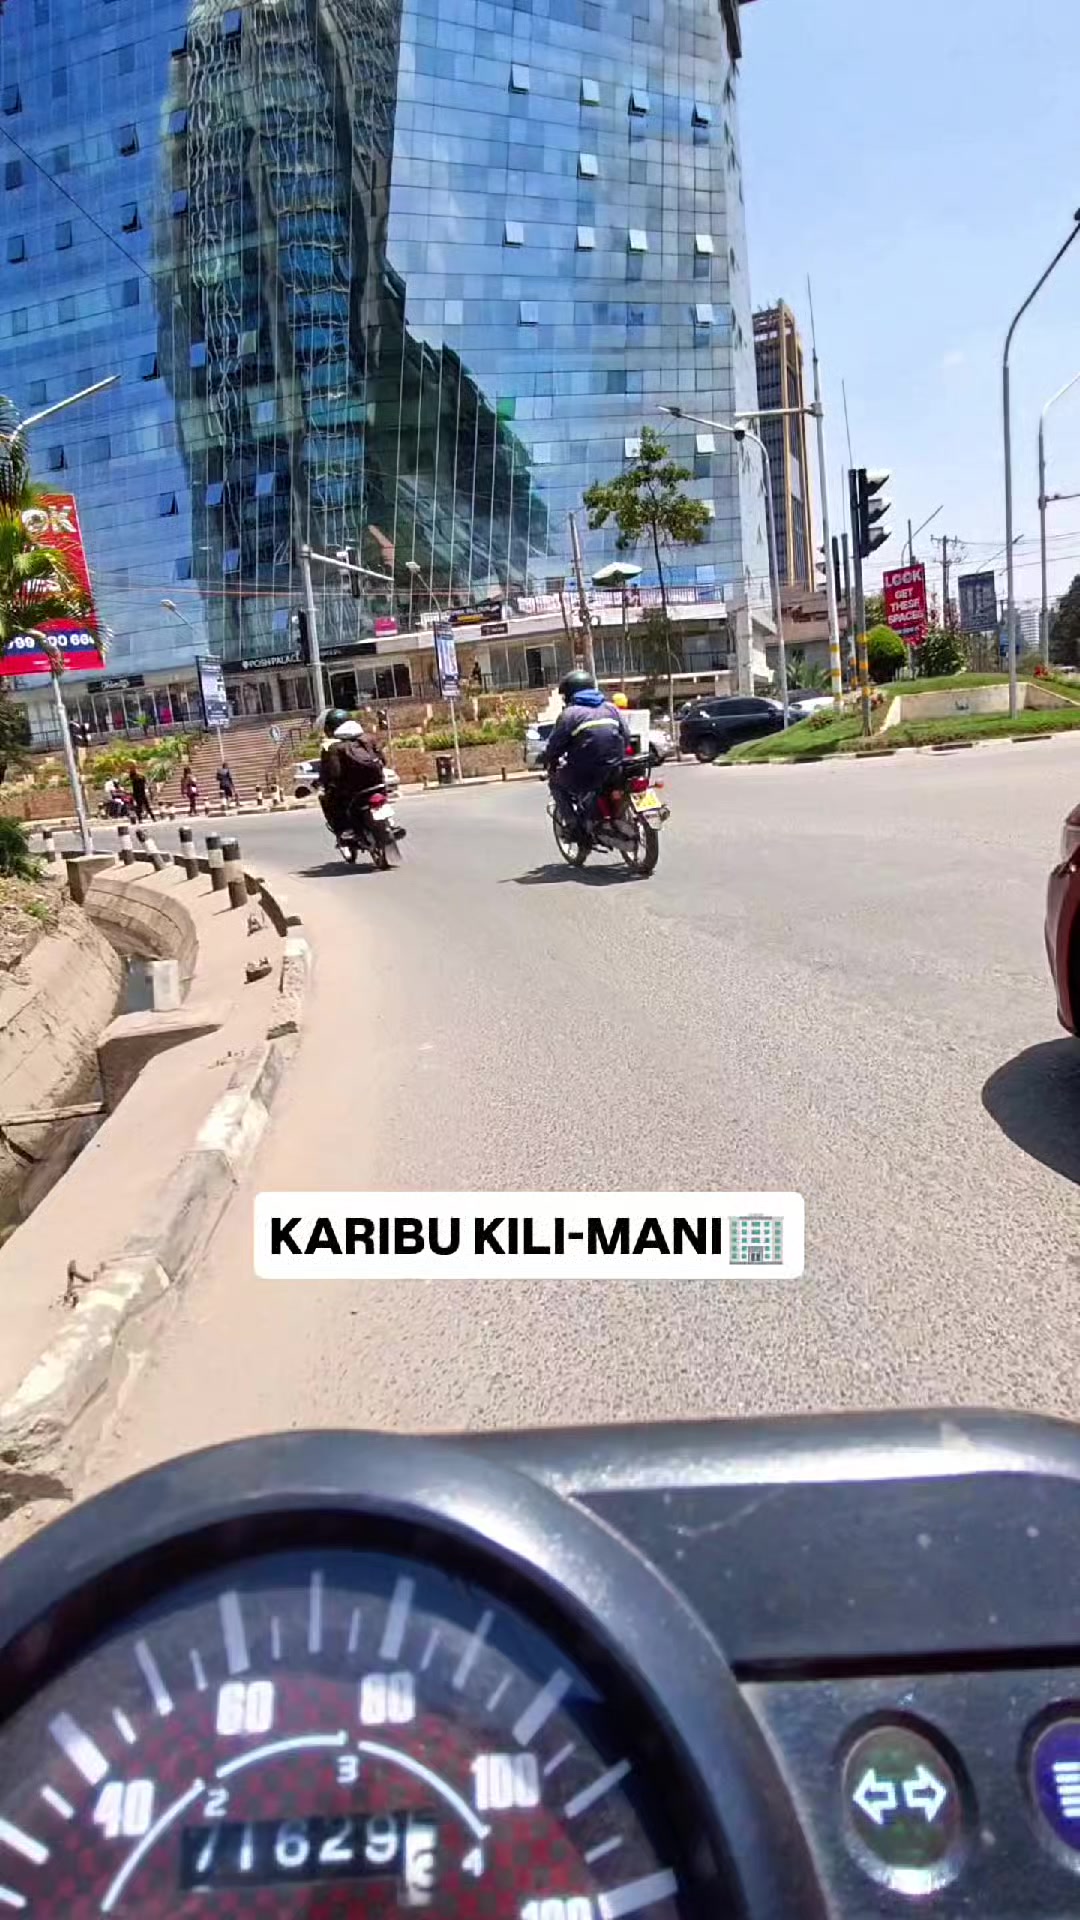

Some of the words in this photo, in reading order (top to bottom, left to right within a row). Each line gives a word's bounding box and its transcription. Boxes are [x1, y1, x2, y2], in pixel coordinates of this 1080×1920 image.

[885, 569, 922, 587] LOOK
[889, 598, 920, 612] THESE
[895, 588, 914, 599] GET
[217, 1681, 274, 1735] 60
[360, 1672, 415, 1724] 80
[337, 1756, 360, 1784] 3
[471, 1753, 539, 1810] 100
[94, 1779, 154, 1839] 40
[204, 1789, 230, 1817] 2
[461, 1847, 486, 1876] 4
